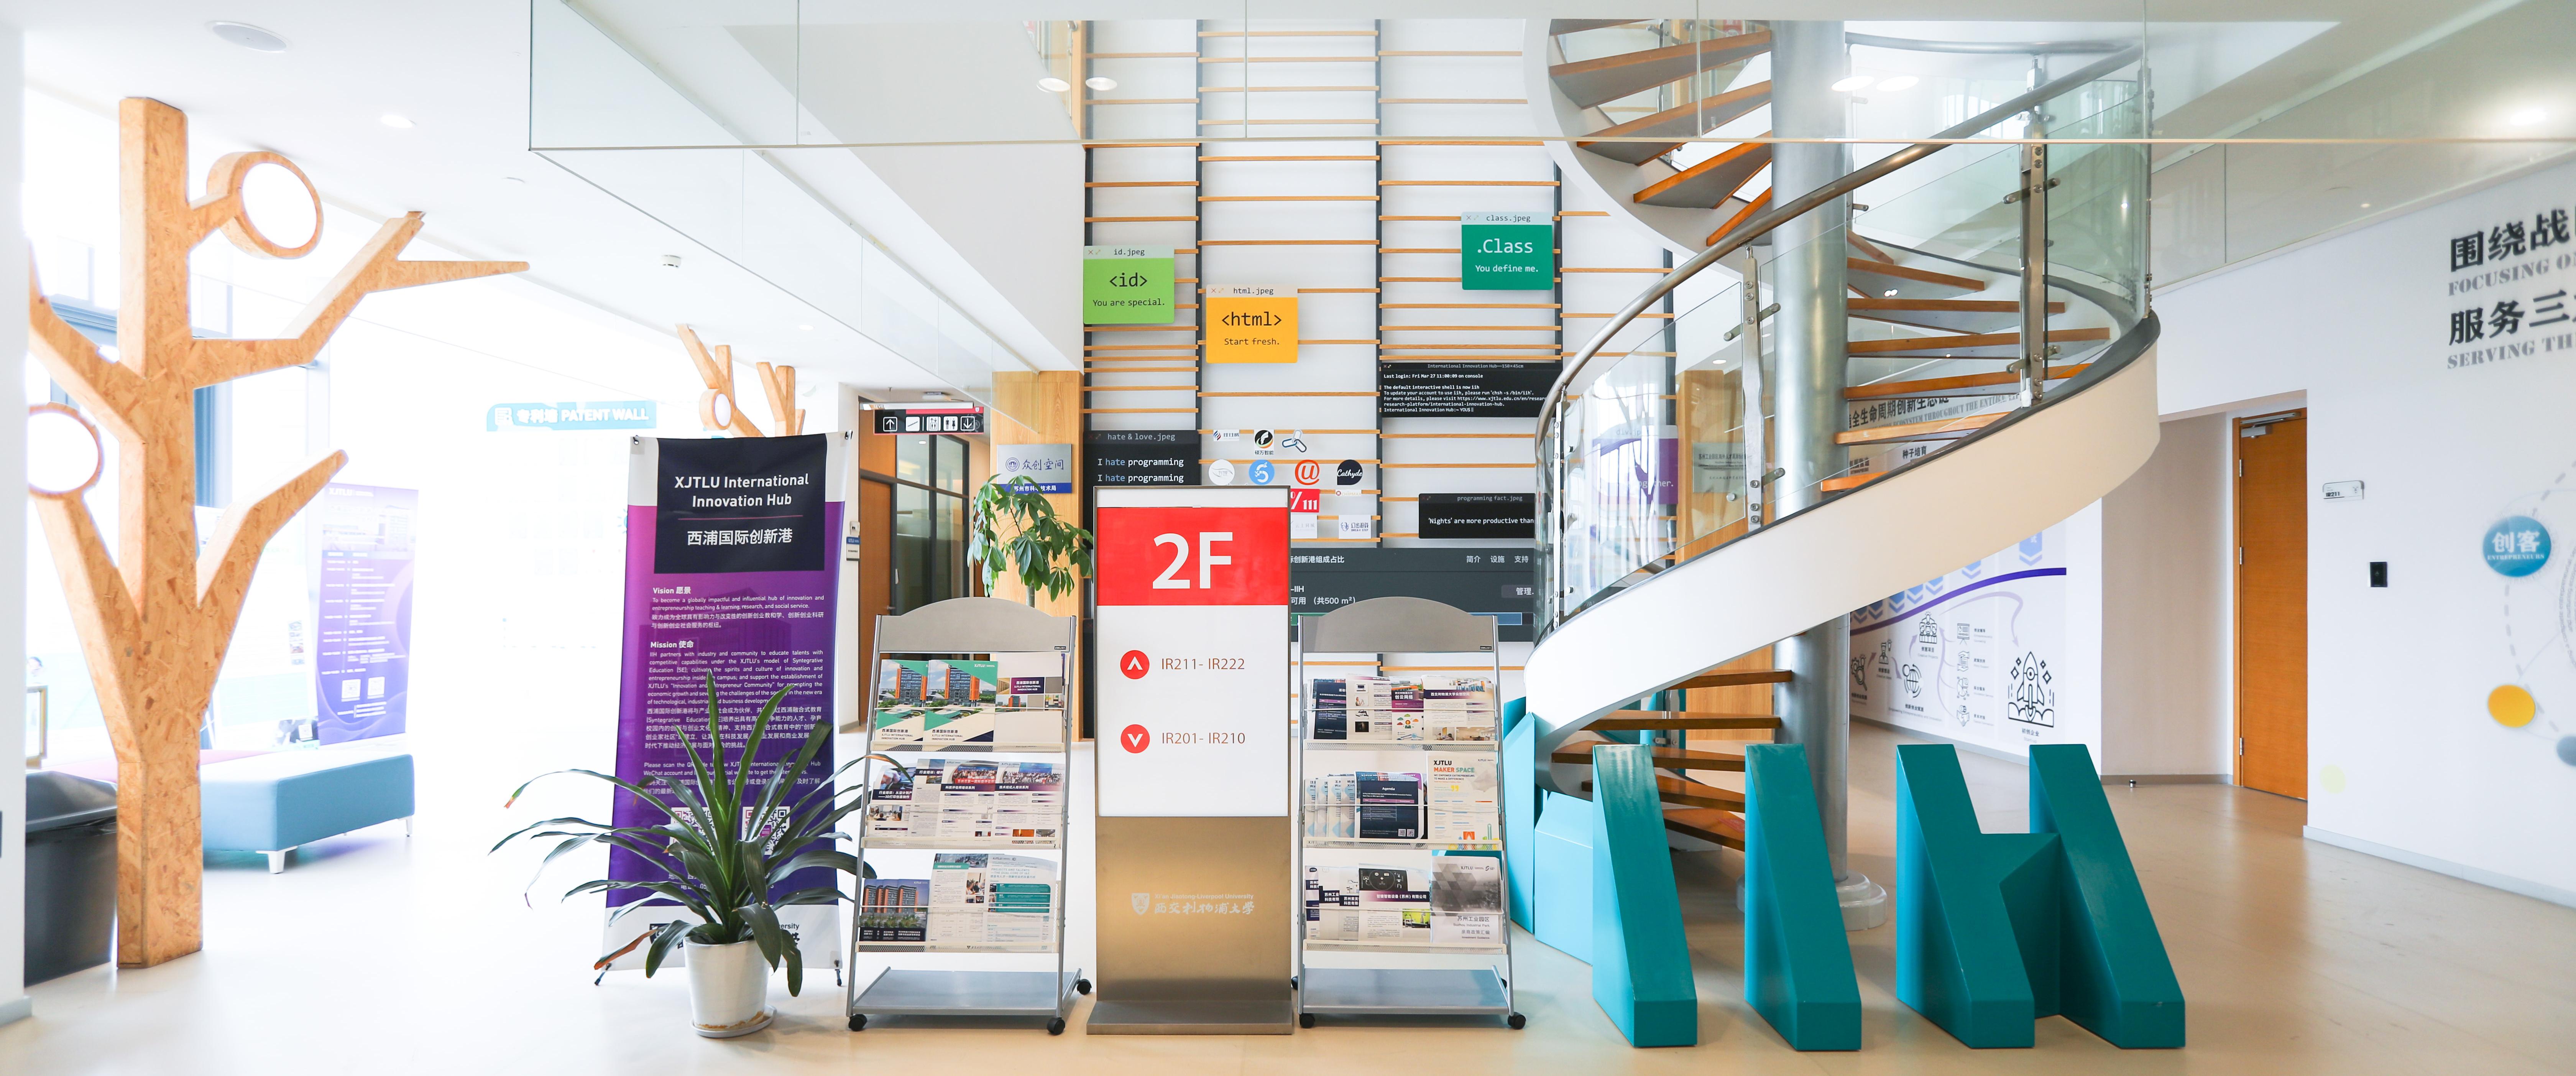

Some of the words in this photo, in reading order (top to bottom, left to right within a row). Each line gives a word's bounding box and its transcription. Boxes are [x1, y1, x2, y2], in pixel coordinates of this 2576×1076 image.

[1486, 214, 1531, 223] class.jpeg
[2450, 206, 2576, 272] 围绕战
[1114, 248, 1145, 256] id.jpeg
[1477, 239, 1533, 253] .Class
[1109, 272, 1148, 287] <id>
[2448, 258, 2549, 296] FOCUSING
[1233, 287, 1273, 295] html.jpeg
[1128, 298, 1165, 308] special.
[1222, 311, 1282, 326] <html>
[2449, 290, 2576, 346] 服务三
[2447, 341, 2535, 369] SERVING
[2542, 334, 2576, 352] TH
[561, 409, 611, 422] PATENT
[612, 408, 649, 421] WALL
[1924, 405, 1964, 422] THROUGHOUT
[1966, 400, 1978, 411] THE
[1135, 433, 1175, 441] love.jpeg
[1902, 446, 1927, 459] 种子培育
[1022, 458, 1064, 471] 众创空间
[1105, 458, 1125, 466] hate
[1128, 458, 1184, 468] programming
[1105, 474, 1125, 482] hate
[1128, 474, 1184, 484] programming
[1337, 469, 1363, 479] Cathyde
[674, 476, 720, 489] XJTLU
[724, 473, 809, 488] International
[692, 495, 762, 507] Innovation
[767, 494, 792, 505] Hub
[687, 528, 793, 546] 西浦国际创新港
[2492, 530, 2540, 553] 创客
[1152, 532, 1234, 589] 2F
[1291, 597, 1306, 605] 可用
[678, 640, 694, 648] 使命
[1162, 658, 1203, 670] IR211-
[1208, 658, 1245, 670] IR222
[1162, 732, 1204, 744] IR201-
[1208, 732, 1246, 744] IR210
